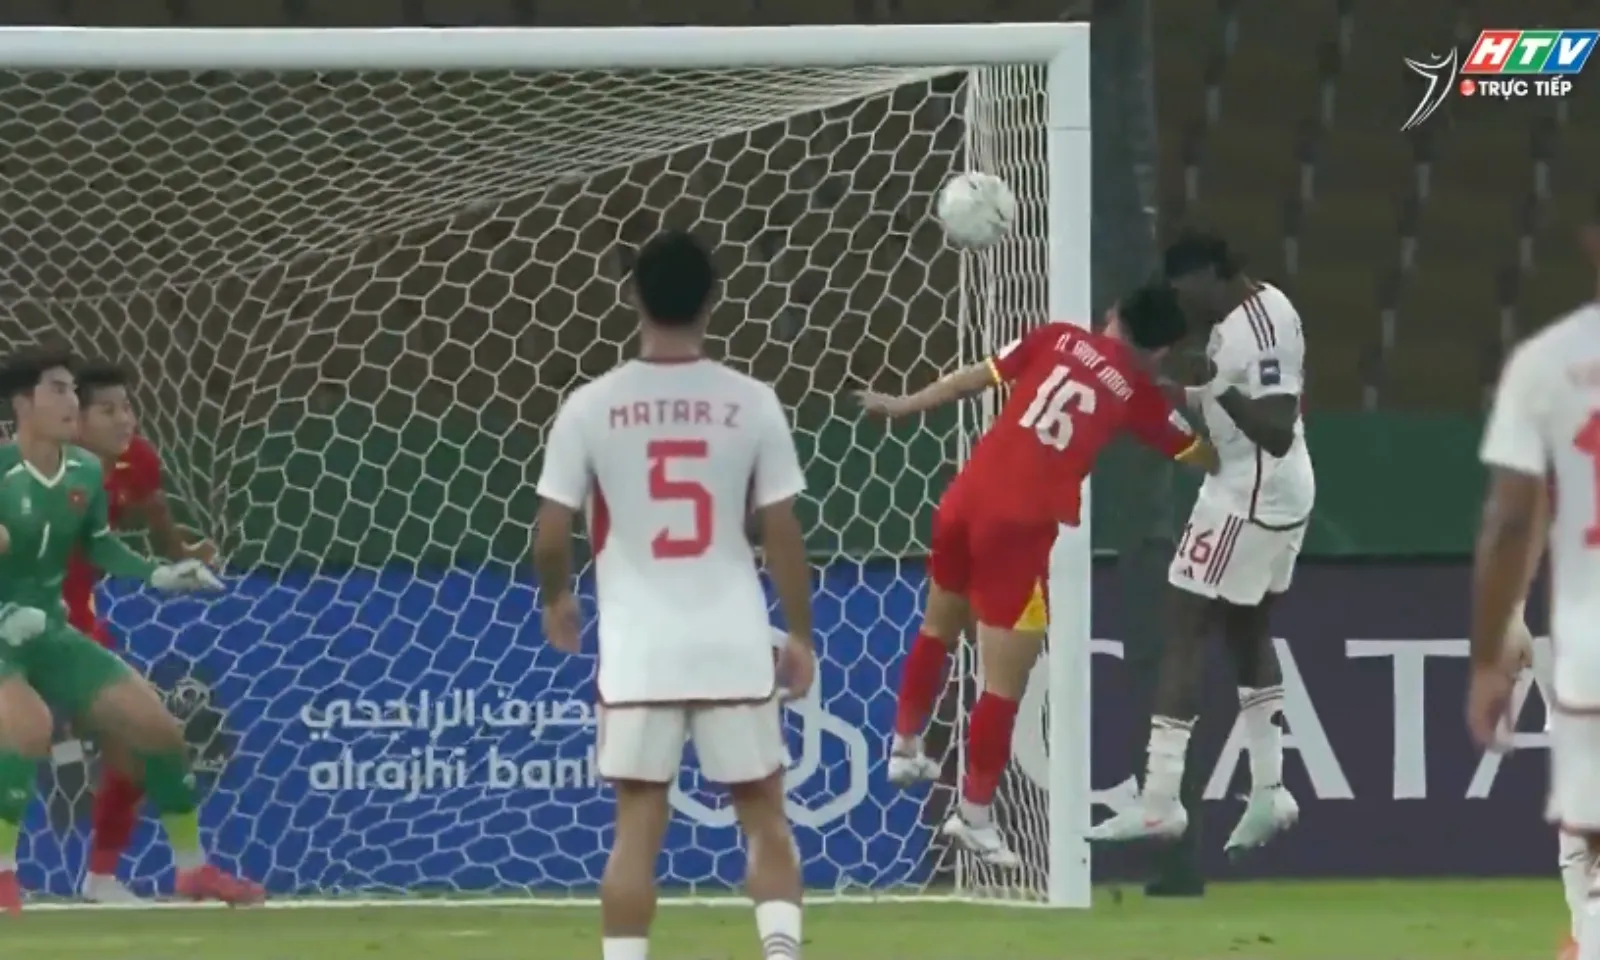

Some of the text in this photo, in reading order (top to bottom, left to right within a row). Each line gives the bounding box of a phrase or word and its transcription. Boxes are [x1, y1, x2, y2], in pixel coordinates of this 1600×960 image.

[1019, 364, 1096, 451] 16
[647, 439, 712, 560] 5
[301, 688, 597, 742] صرف الراجحي
[309, 745, 467, 802] alrajhi
